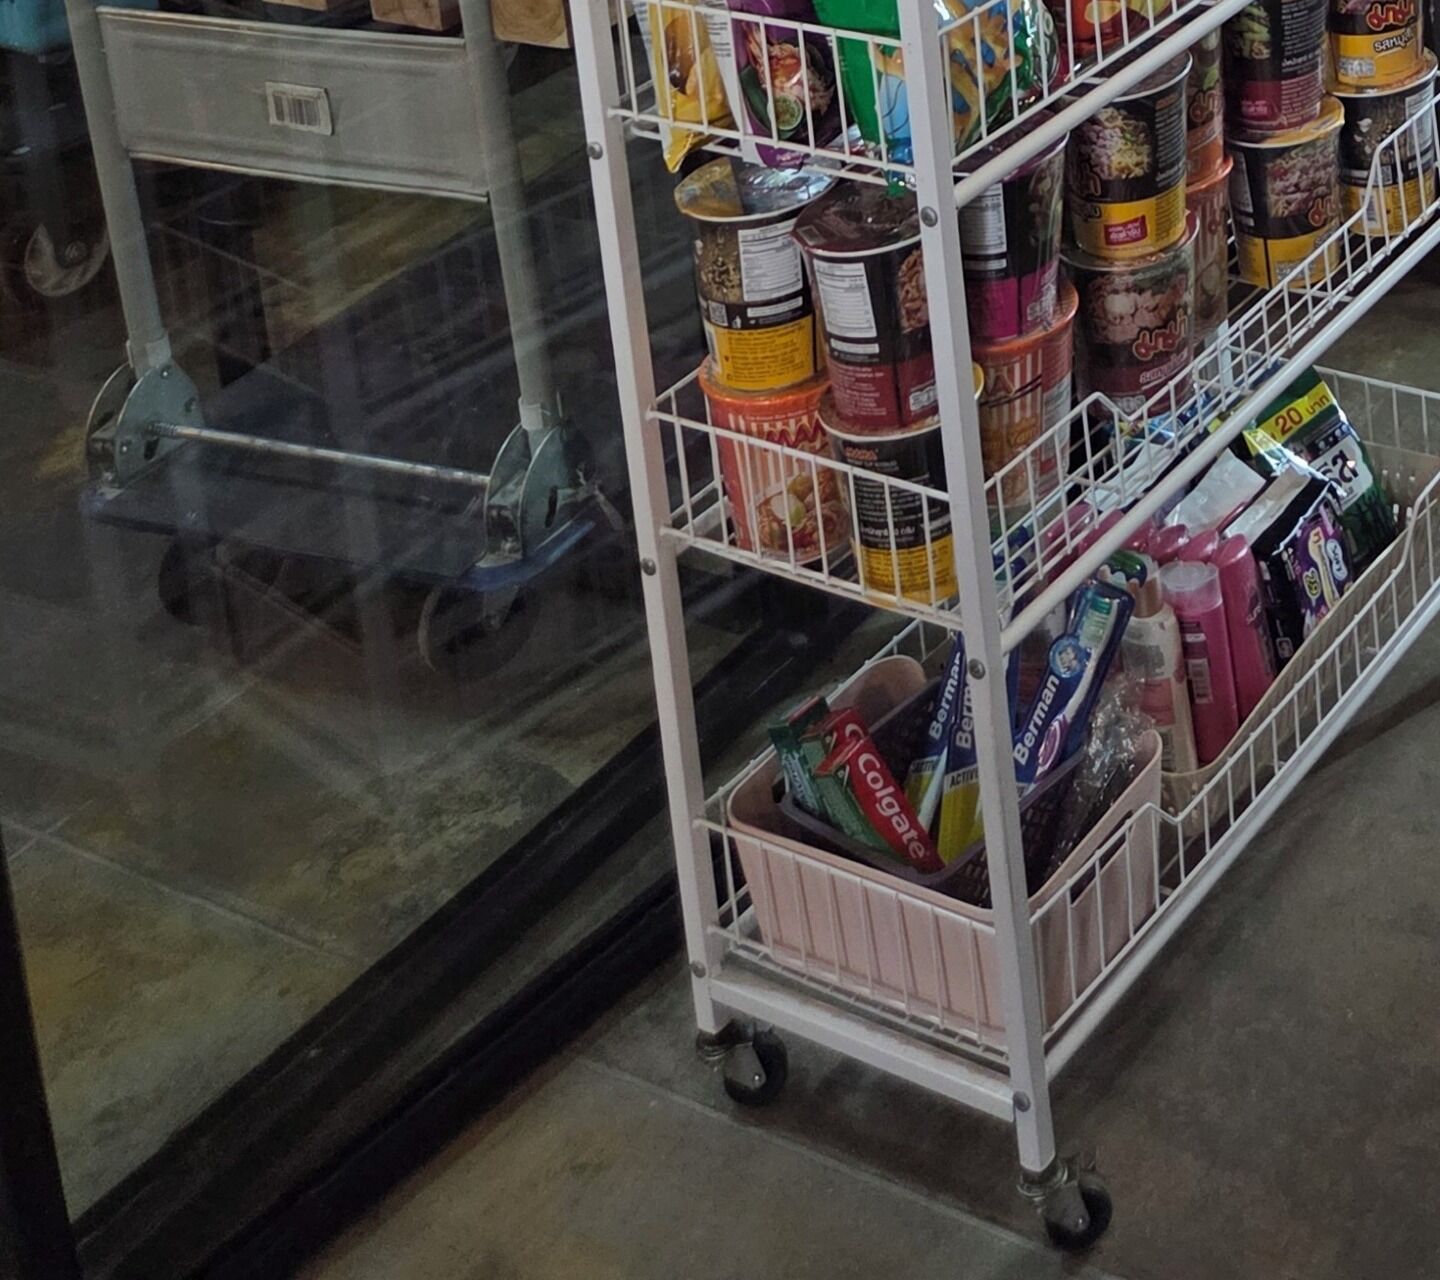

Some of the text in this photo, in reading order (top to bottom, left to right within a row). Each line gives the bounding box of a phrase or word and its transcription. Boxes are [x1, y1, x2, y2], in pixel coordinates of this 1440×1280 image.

[1274, 393, 1330, 437] 20 บาท
[1013, 674, 1060, 766] Berman
[857, 751, 929, 862] Colgate
